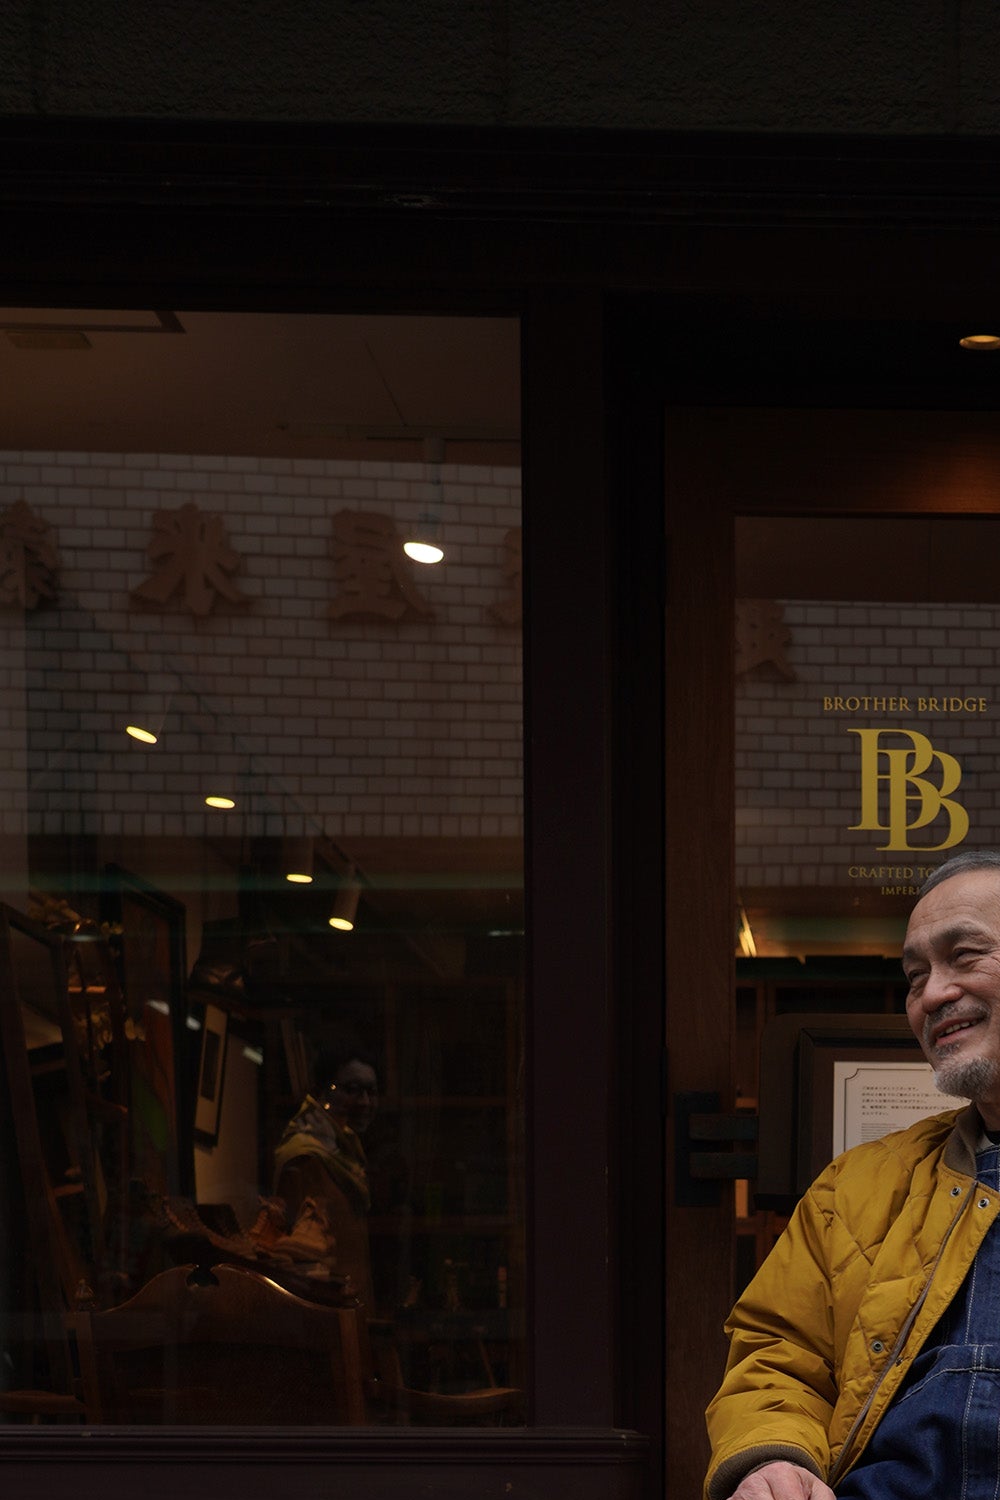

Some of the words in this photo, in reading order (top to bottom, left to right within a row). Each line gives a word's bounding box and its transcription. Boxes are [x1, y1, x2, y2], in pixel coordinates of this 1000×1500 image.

[823, 697, 910, 711] BROTHER
[917, 697, 987, 712] BRIDGE
[848, 866, 914, 879] CRAFTED
[881, 886, 920, 895] IMPERI
